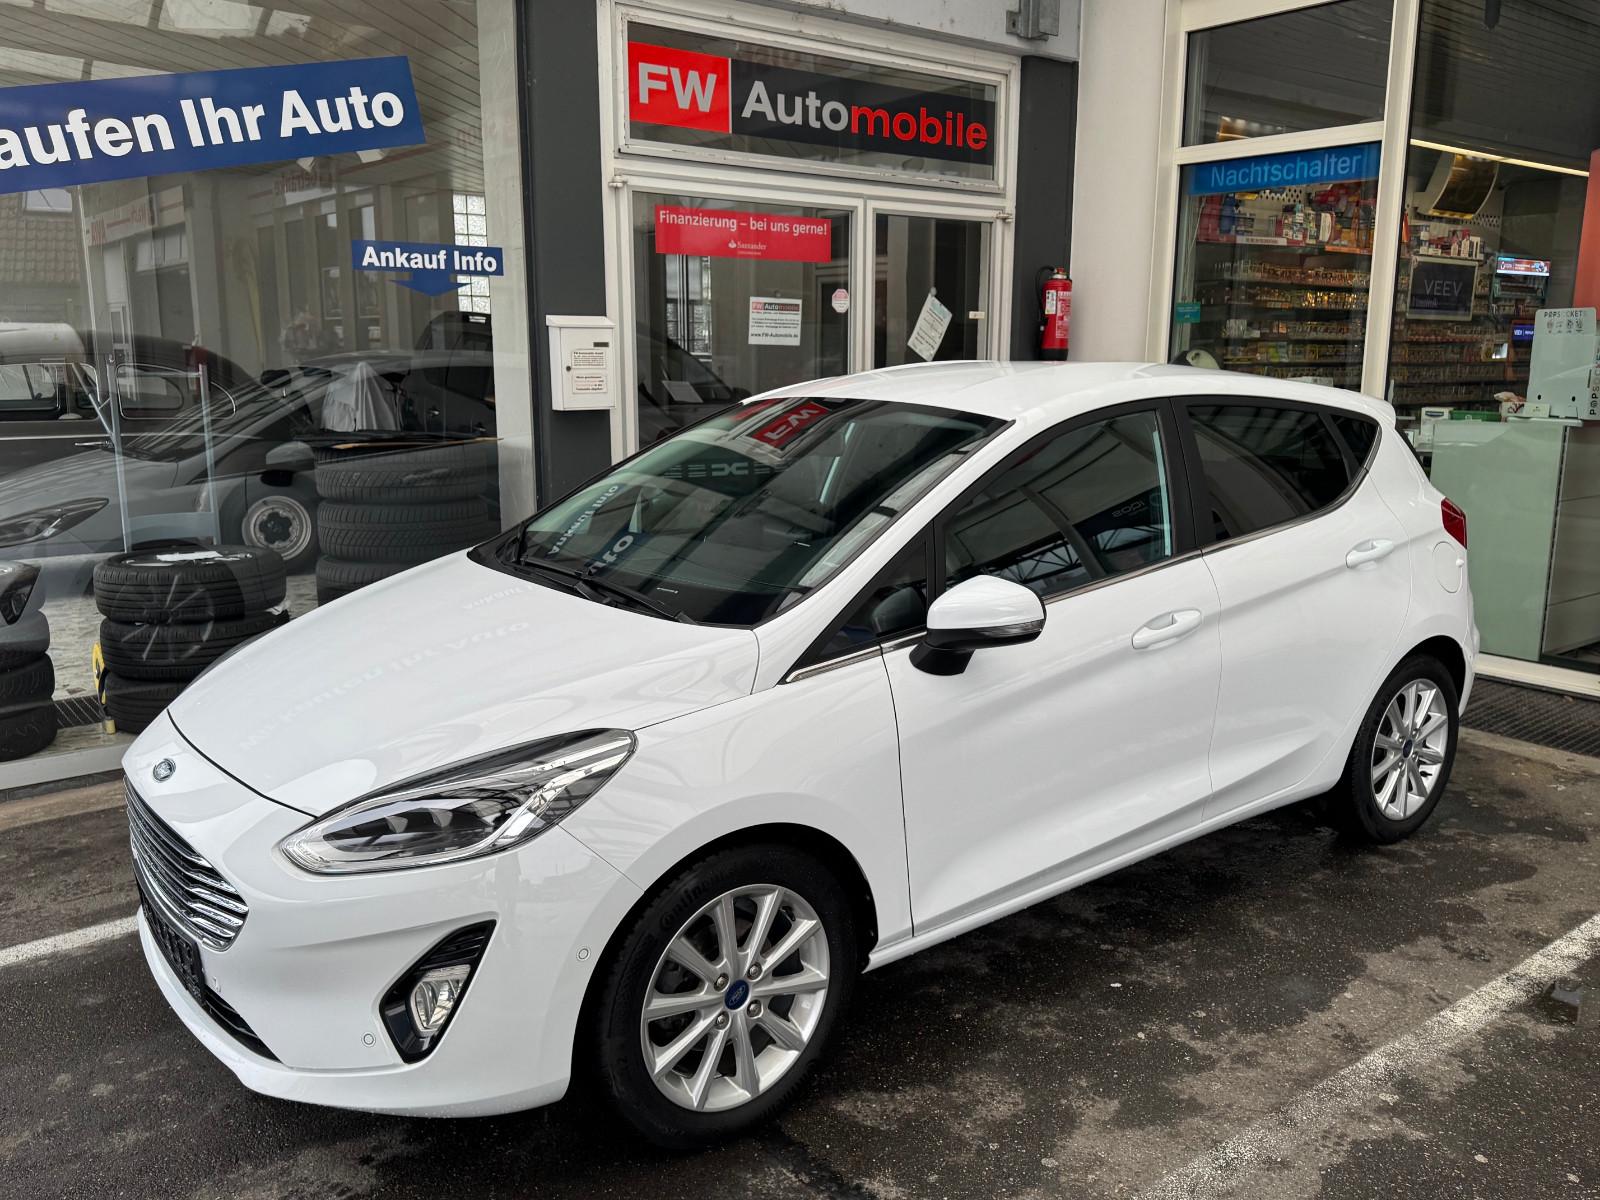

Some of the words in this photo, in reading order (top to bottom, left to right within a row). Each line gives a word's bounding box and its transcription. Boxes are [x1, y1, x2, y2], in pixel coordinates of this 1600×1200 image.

[180, 97, 265, 148] Ihr
[279, 86, 404, 138] Auto
[638, 62, 718, 113] FW
[741, 80, 988, 151] Automobile
[1210, 153, 1362, 188] Nachtschalter
[659, 210, 737, 232] Finanzierung
[749, 217, 767, 231] bei
[770, 222, 790, 233] uns
[792, 223, 827, 237] gerne!
[362, 246, 447, 270] Ankauf
[453, 250, 497, 272] Info
[1424, 279, 1463, 297] VEEV
